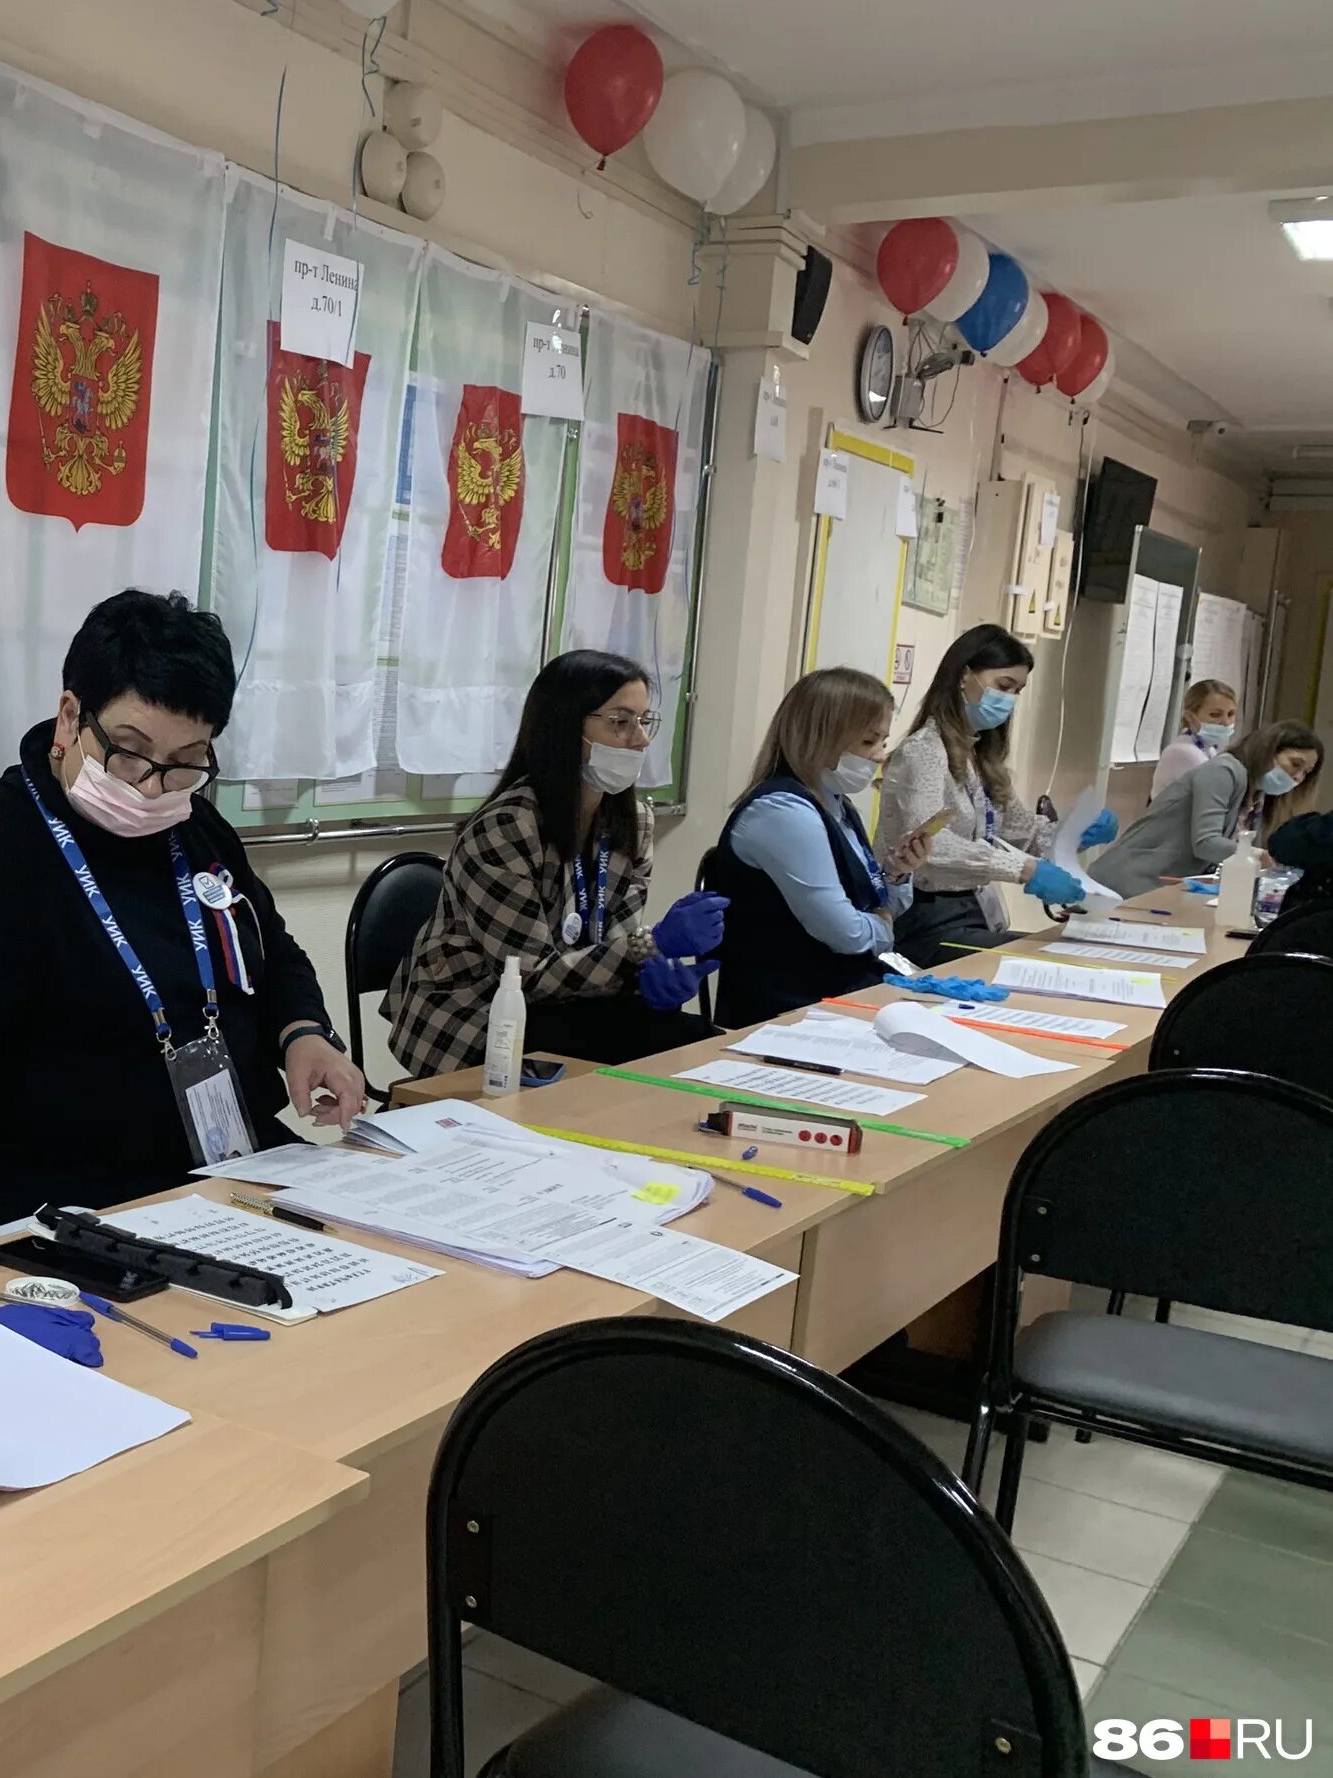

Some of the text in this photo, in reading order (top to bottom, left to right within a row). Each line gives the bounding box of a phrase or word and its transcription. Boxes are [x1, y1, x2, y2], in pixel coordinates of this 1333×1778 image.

[294, 260, 358, 292] пр-т Ленина
[310, 295, 342, 317] д.70/1
[48, 817, 75, 849] УИК
[598, 850, 609, 874] УИК
[74, 864, 100, 899] УИК
[176, 872, 197, 906] УИК
[597, 885, 606, 909] УИК
[101, 914, 128, 948] УИК
[188, 918, 208, 951] УИК
[131, 963, 157, 999] УИК
